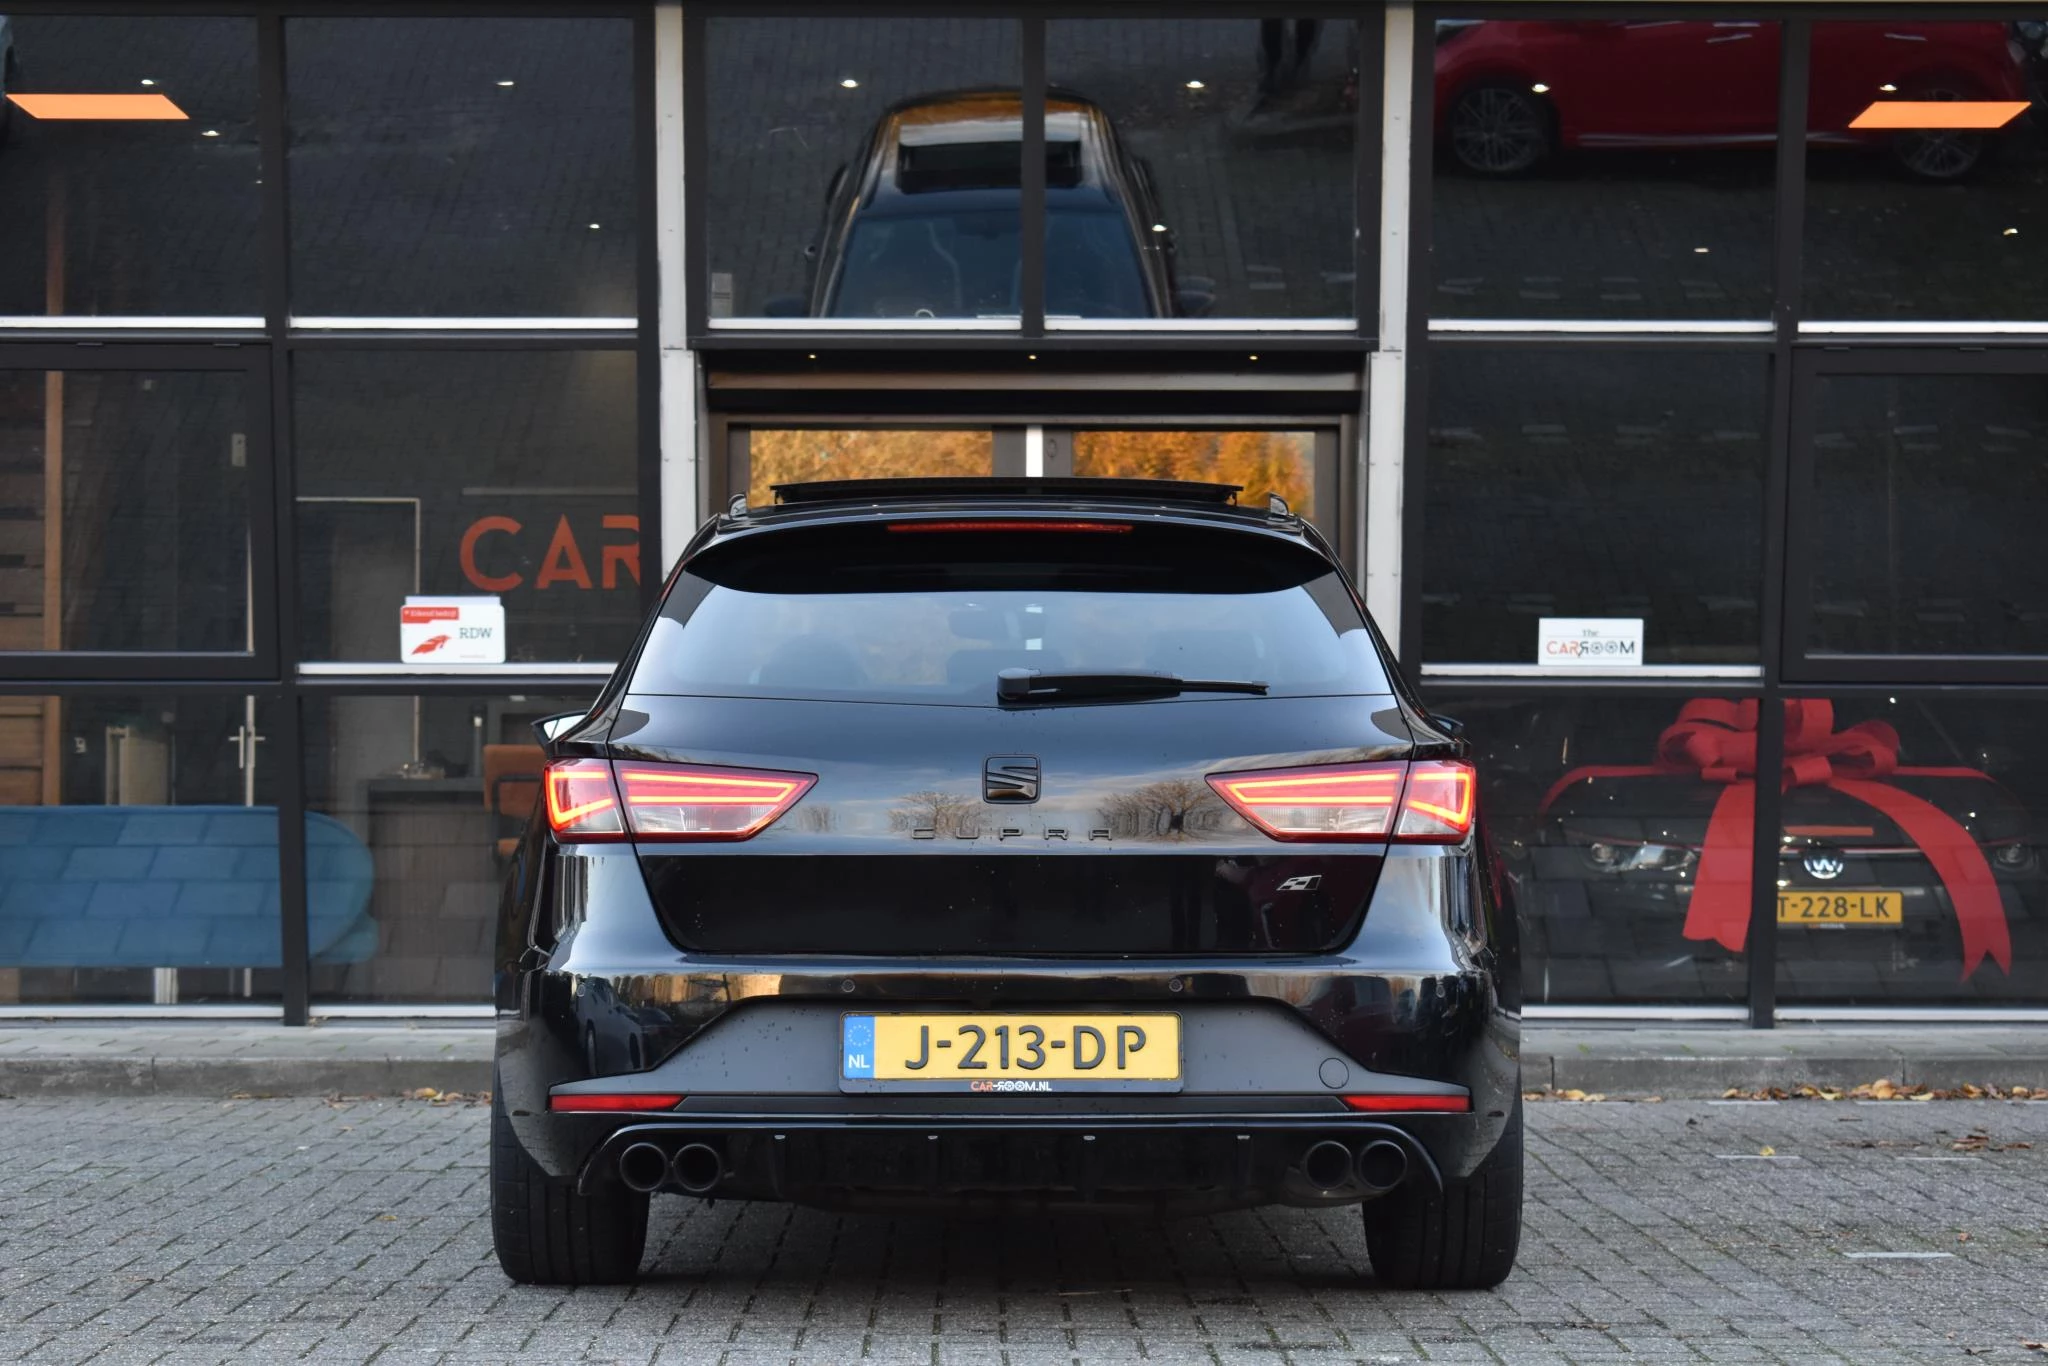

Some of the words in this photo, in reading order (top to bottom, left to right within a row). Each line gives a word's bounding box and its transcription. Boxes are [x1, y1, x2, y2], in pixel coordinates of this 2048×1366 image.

[460, 513, 641, 592] CAR
[458, 627, 493, 640] RDW
[911, 827, 1113, 841] CUPRA
[1778, 896, 1890, 918] T-228-LK
[905, 1024, 1147, 1070] J-213-DP
[848, 1054, 870, 1069] NL
